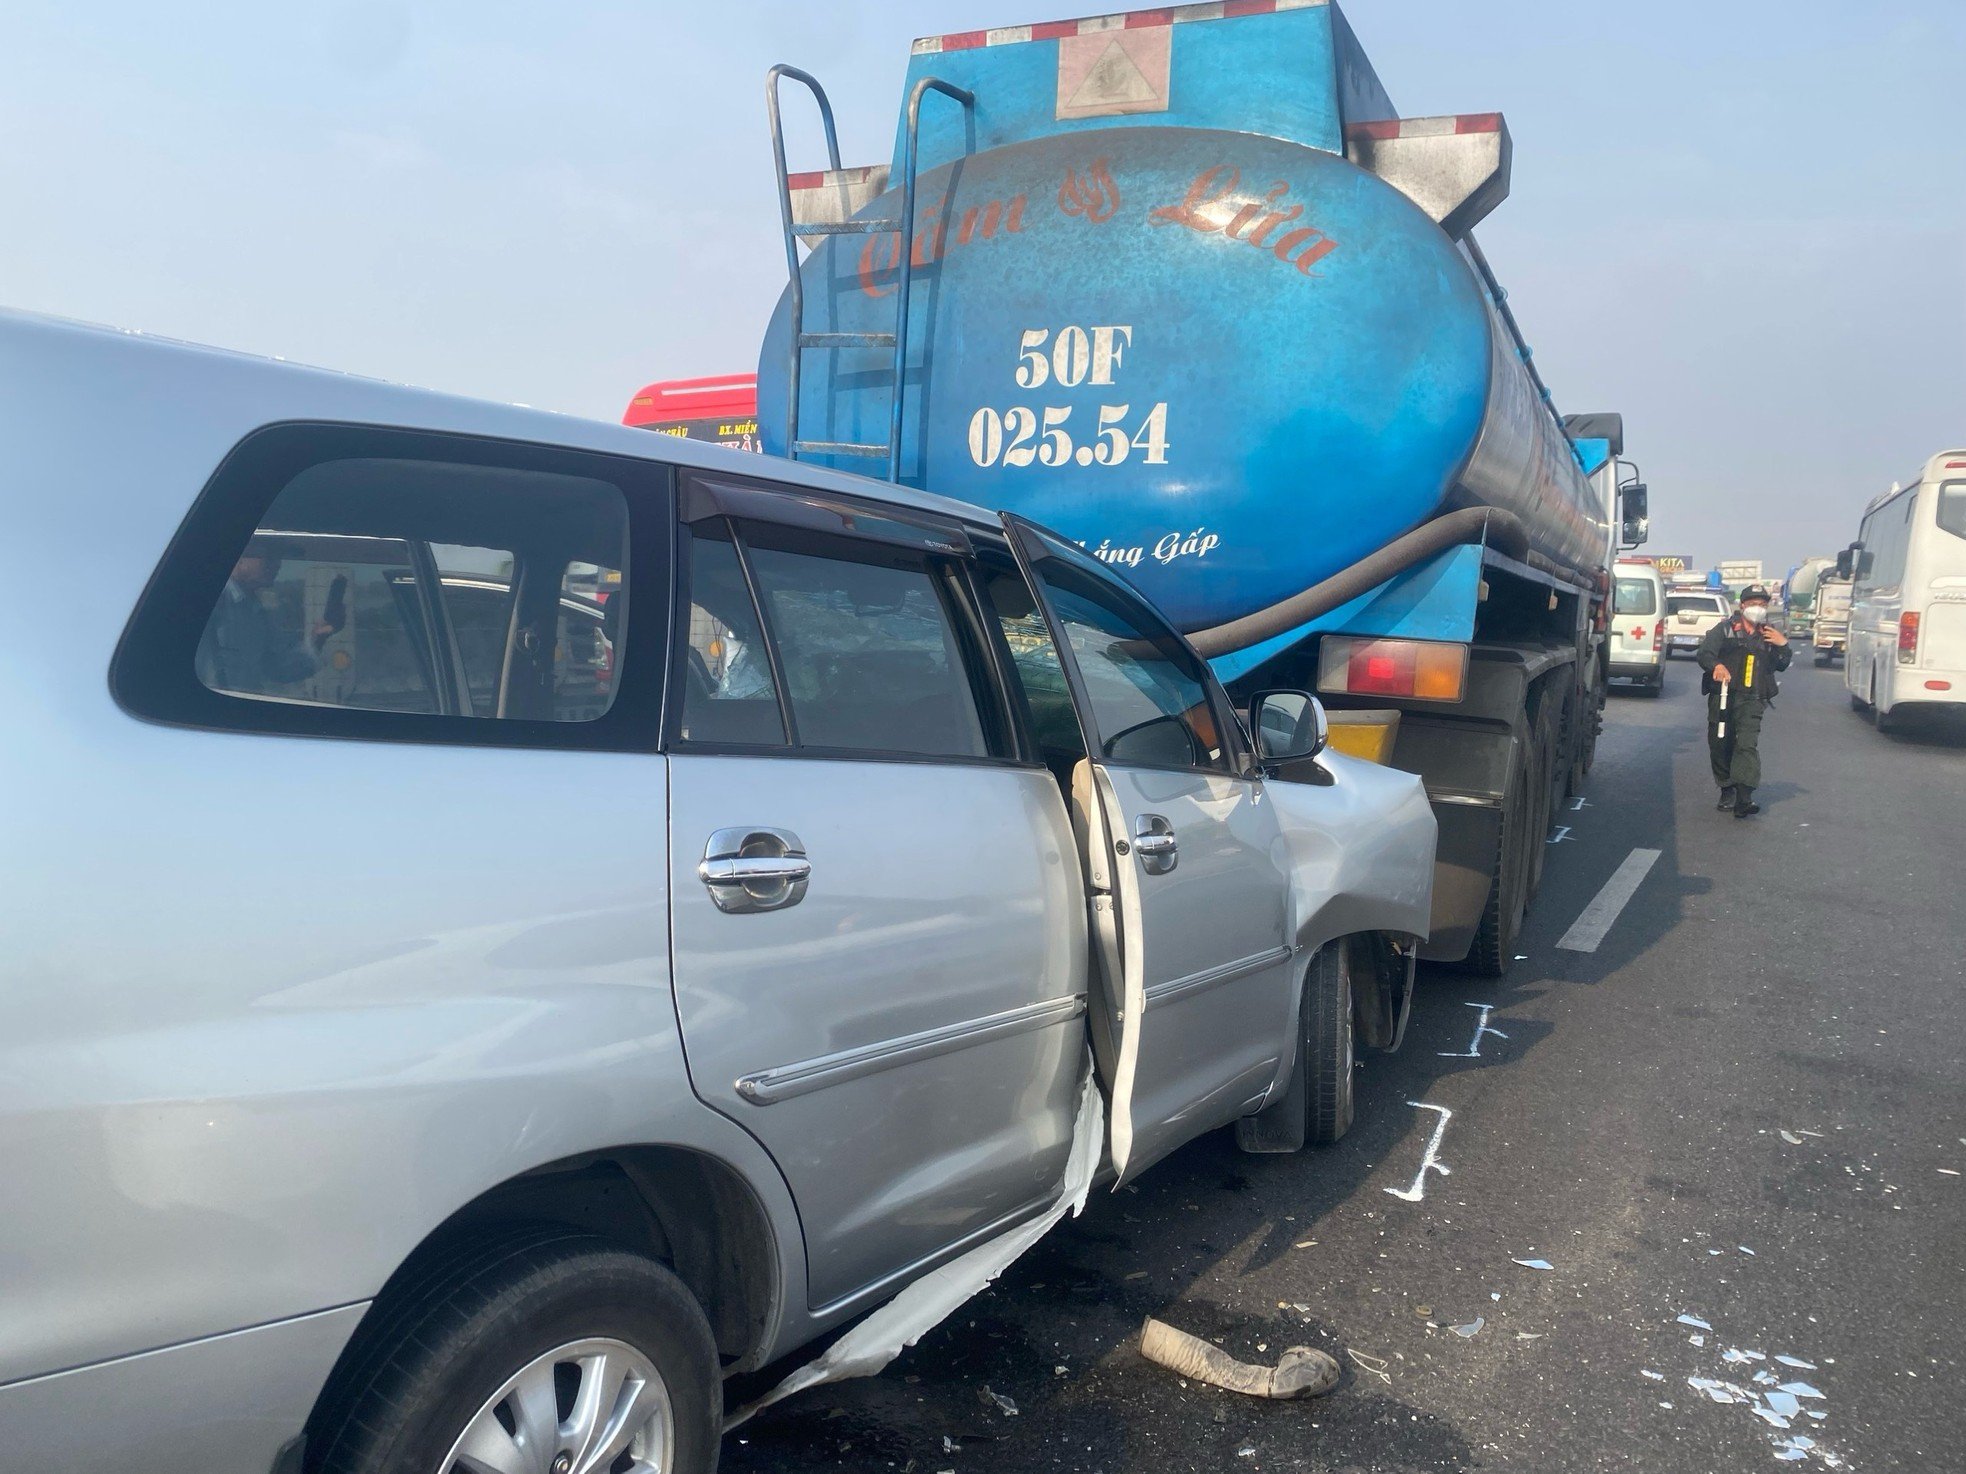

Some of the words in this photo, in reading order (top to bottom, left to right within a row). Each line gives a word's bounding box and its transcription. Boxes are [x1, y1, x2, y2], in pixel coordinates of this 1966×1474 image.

[858, 192, 1036, 299] Cấm
[1148, 163, 1341, 279] Lửa
[1015, 325, 1133, 389] 50F
[968, 402, 1171, 467] 025.54
[1073, 539, 1145, 568] ắng
[1151, 526, 1221, 565] Gấp
[1660, 557, 1685, 567] KITA
